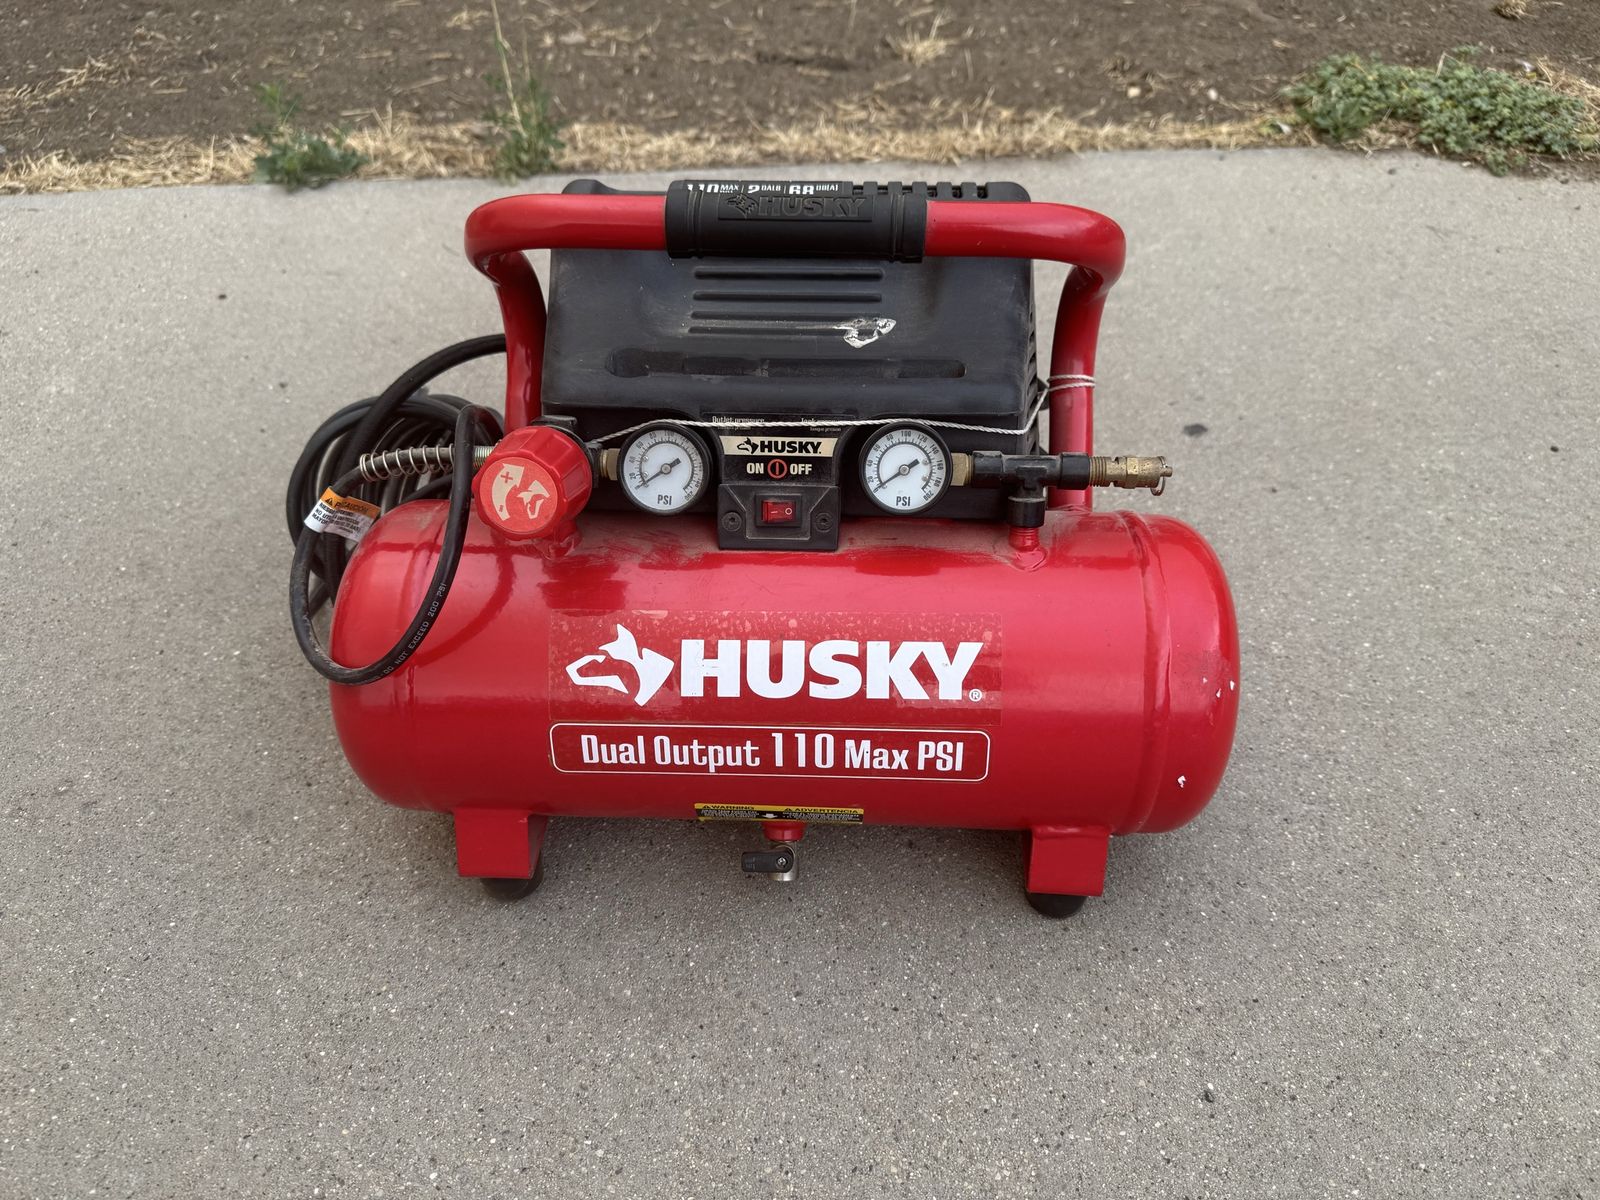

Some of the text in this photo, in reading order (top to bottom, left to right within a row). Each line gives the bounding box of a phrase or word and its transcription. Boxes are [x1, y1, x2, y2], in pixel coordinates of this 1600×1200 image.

[758, 195, 866, 217] HUSKY
[917, 433, 928, 443] 120
[929, 444, 939, 455] 140
[746, 462, 812, 475] ON OFF
[936, 460, 944, 471] 160
[657, 494, 672, 506] PSI
[896, 496, 911, 507] PSI
[408, 621, 430, 649] EXCEED
[427, 601, 439, 617] 200
[436, 583, 447, 597] PSI
[580, 732, 964, 773] Dual Output 110 Max PSI
